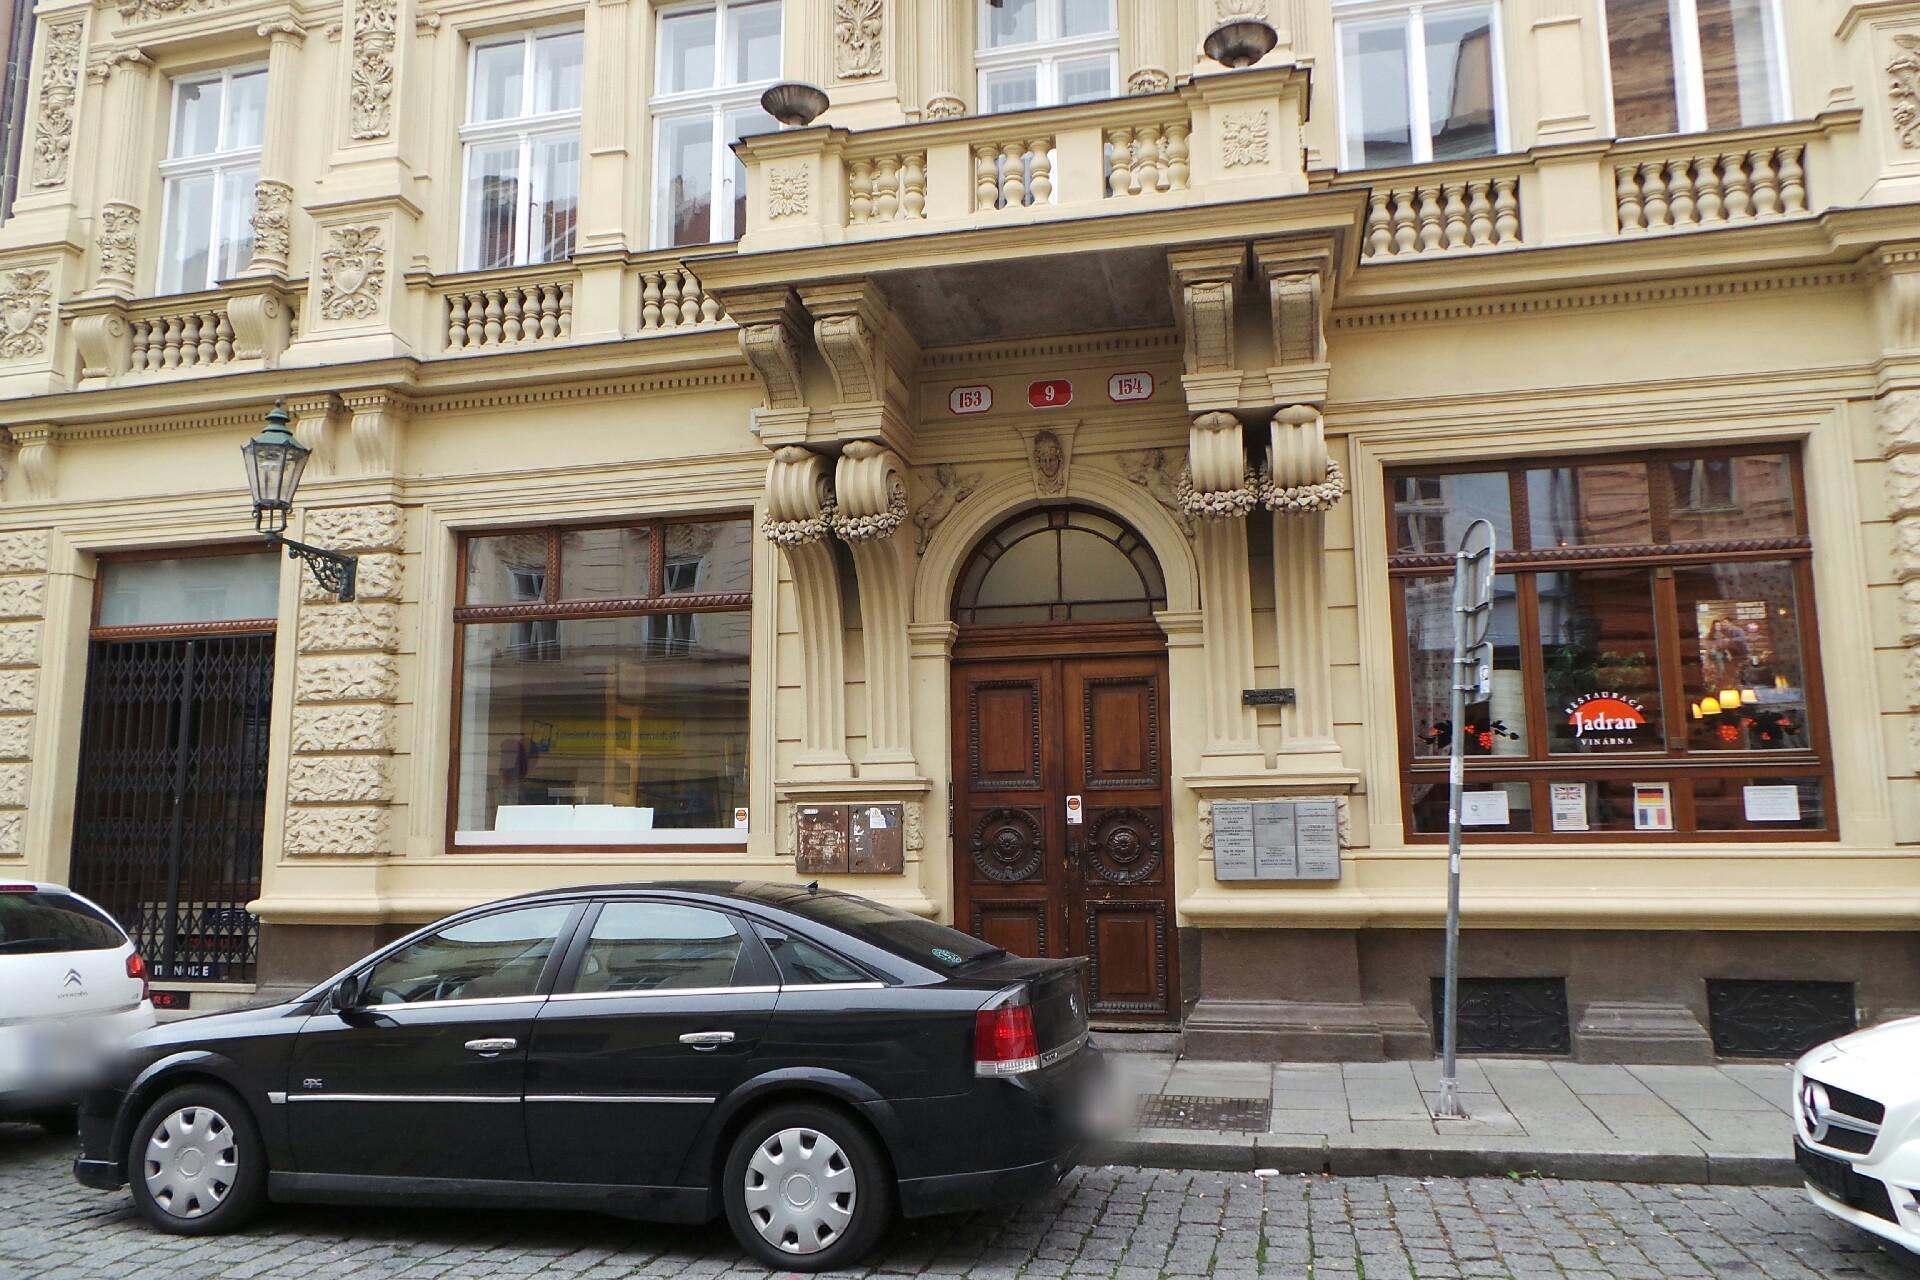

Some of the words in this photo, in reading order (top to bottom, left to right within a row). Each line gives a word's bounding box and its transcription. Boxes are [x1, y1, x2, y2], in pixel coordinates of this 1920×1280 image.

[1045, 385, 1055, 401] 9
[1118, 378, 1143, 395] 154
[959, 391, 982, 408] 153
[1565, 691, 1644, 714] RESTAURACE
[1574, 711, 1637, 737] Jadran
